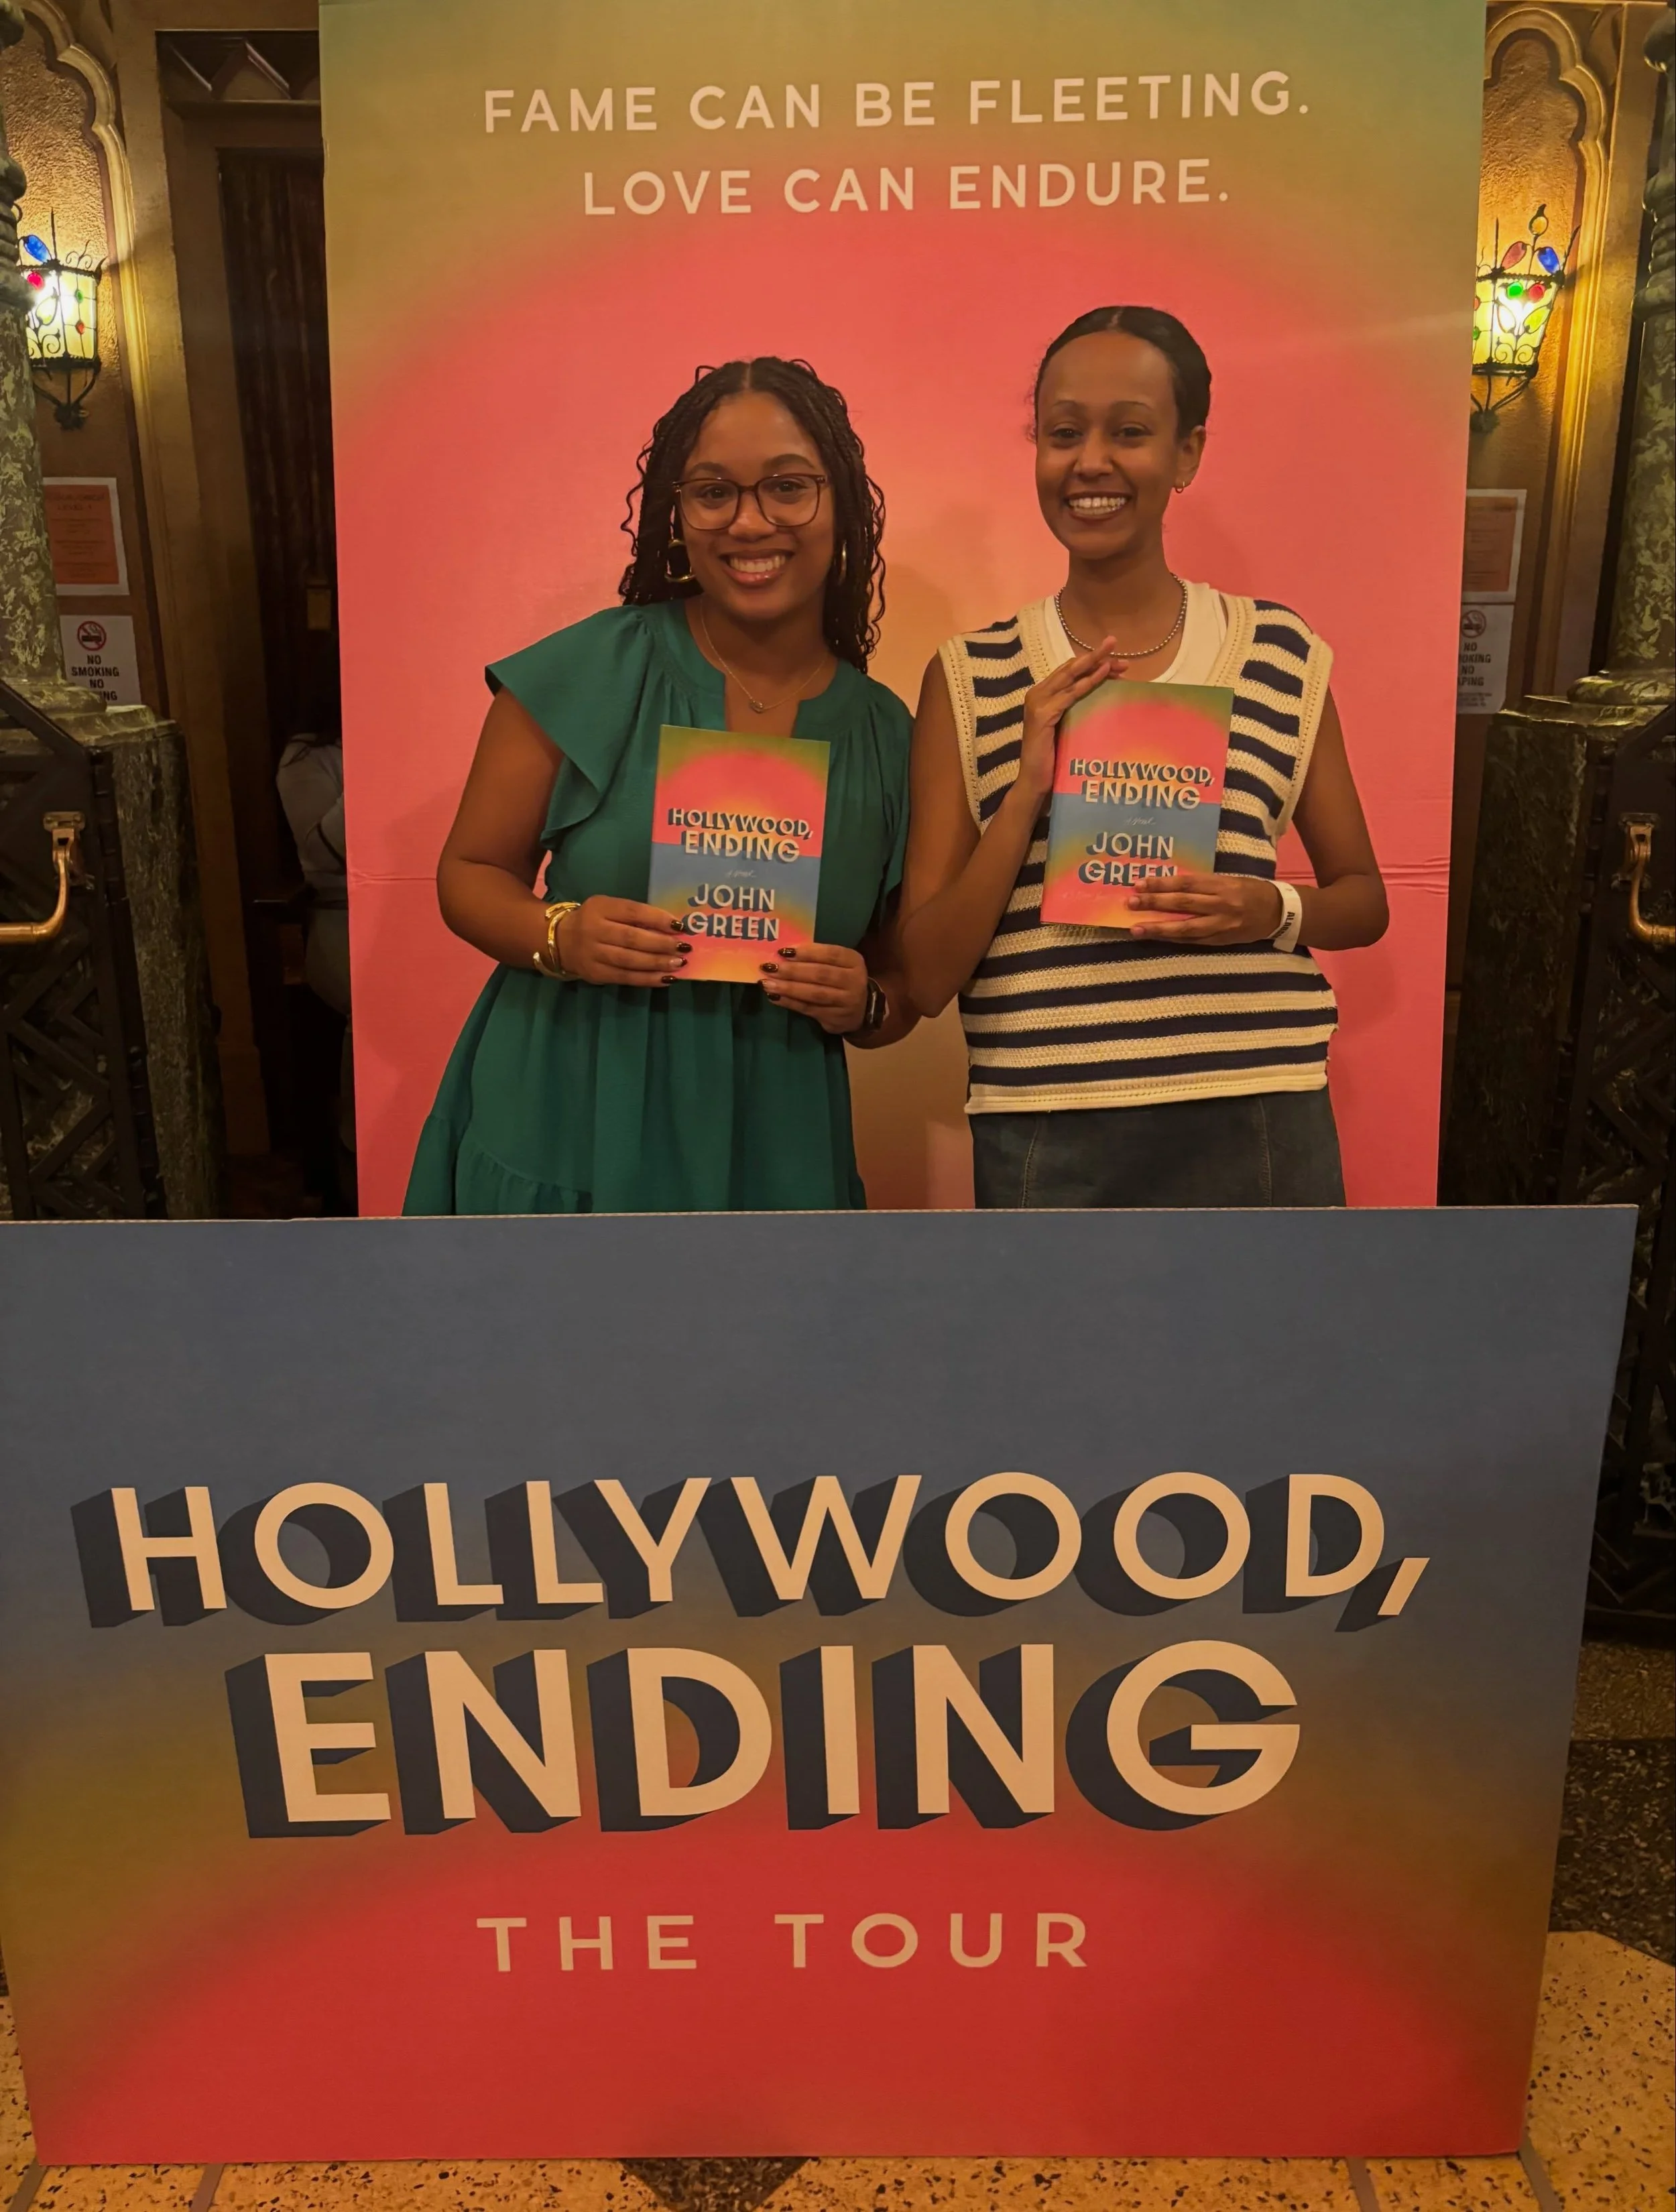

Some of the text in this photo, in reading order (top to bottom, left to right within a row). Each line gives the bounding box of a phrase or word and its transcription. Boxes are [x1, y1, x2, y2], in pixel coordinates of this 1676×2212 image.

[485, 70, 1309, 133] FAME CAN BE FLEETING.
[584, 158, 1229, 217] LOVE CAN ENDURE.
[71, 666, 119, 676] SMOKING
[87, 654, 101, 664] NO
[1459, 654, 1491, 663] OKING
[1461, 665, 1474, 675] NO
[89, 678, 104, 688] NO
[1071, 758, 1215, 786] HOLLYWOOD,
[1083, 780, 1201, 810] ENDING
[670, 808, 814, 839] HOLLYWOOD,
[682, 831, 800, 863] ENDING
[1088, 831, 1175, 859] JOHN
[691, 883, 776, 912] JOHN
[684, 911, 780, 940] GREEN
[101, 1471, 1430, 1617] HOLLYWOOD,
[251, 1639, 1301, 1825] ENDING
[476, 1912, 1088, 1971] THE TOUR
